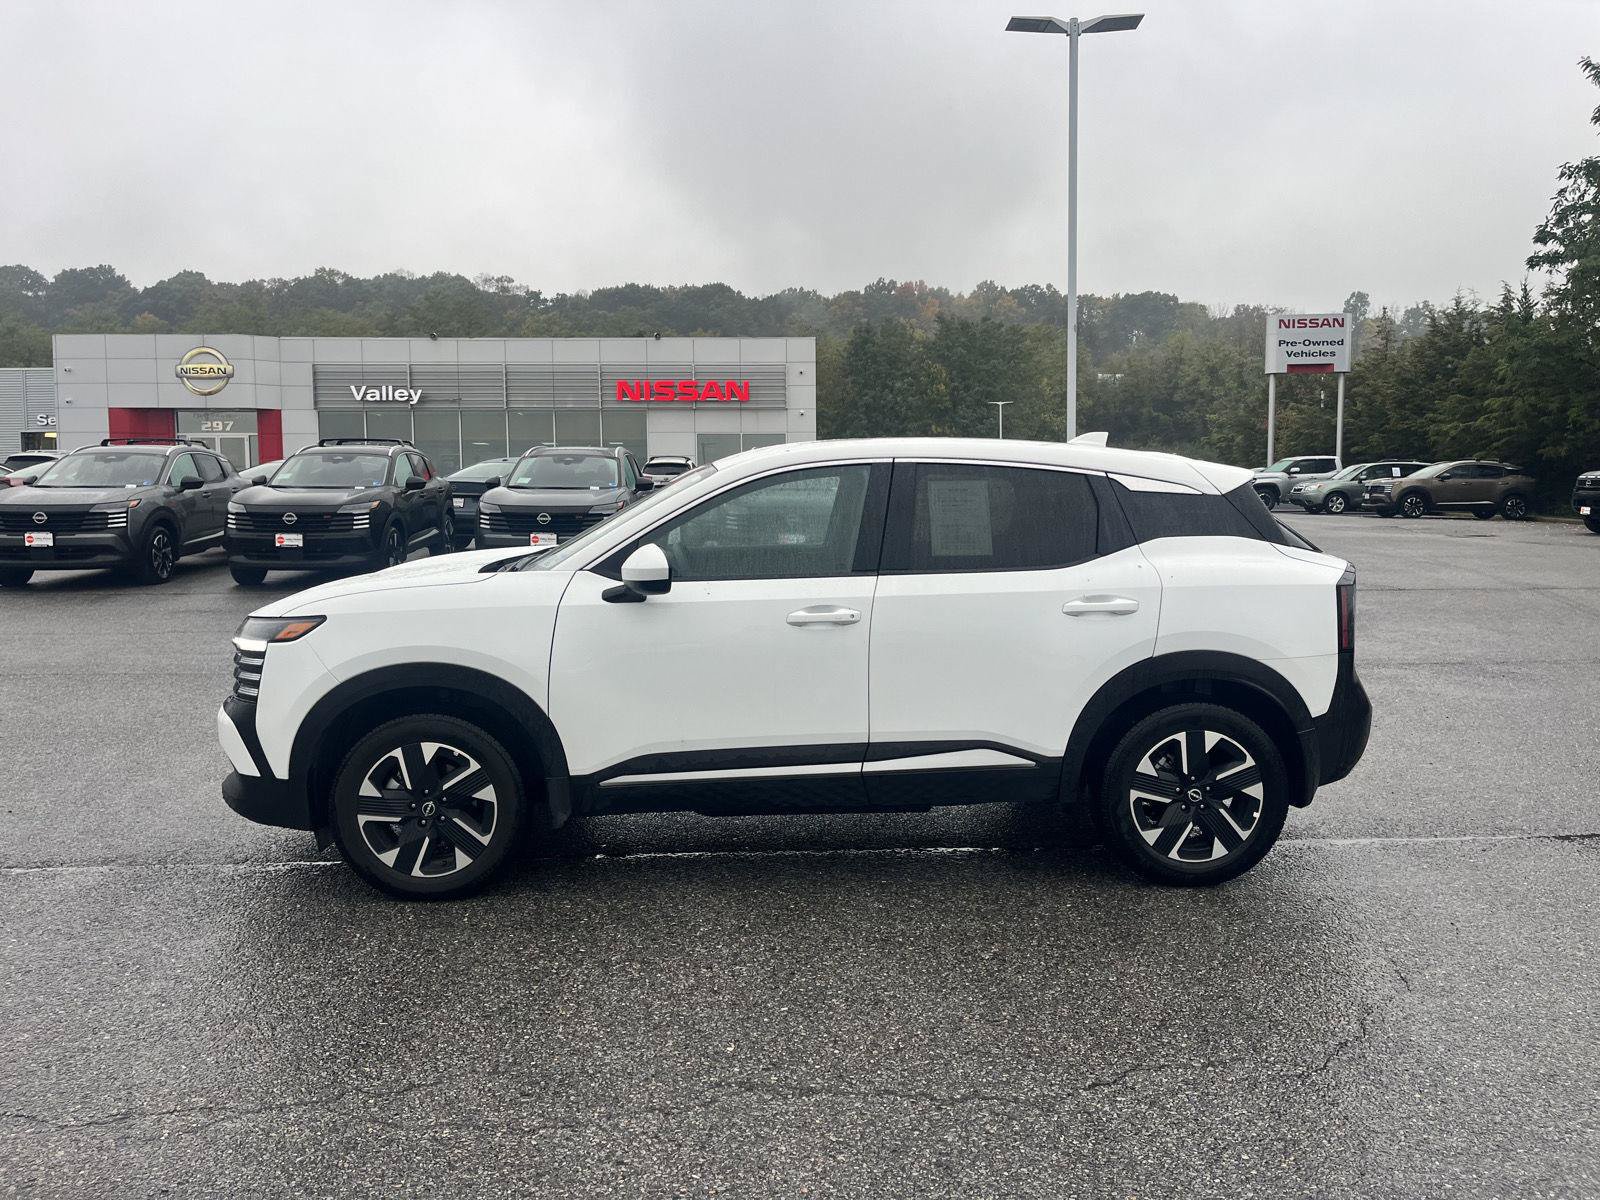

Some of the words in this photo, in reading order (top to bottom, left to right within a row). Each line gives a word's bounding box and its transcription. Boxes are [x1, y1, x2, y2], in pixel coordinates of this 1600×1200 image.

[1279, 318, 1344, 329] NISSAN
[1278, 338, 1344, 347] Pre-Owned
[1286, 350, 1336, 358] Vehicles
[180, 367, 227, 375] NISSAN
[349, 385, 422, 405] Valley
[616, 380, 750, 402] NISSAN
[201, 420, 234, 432] 297
